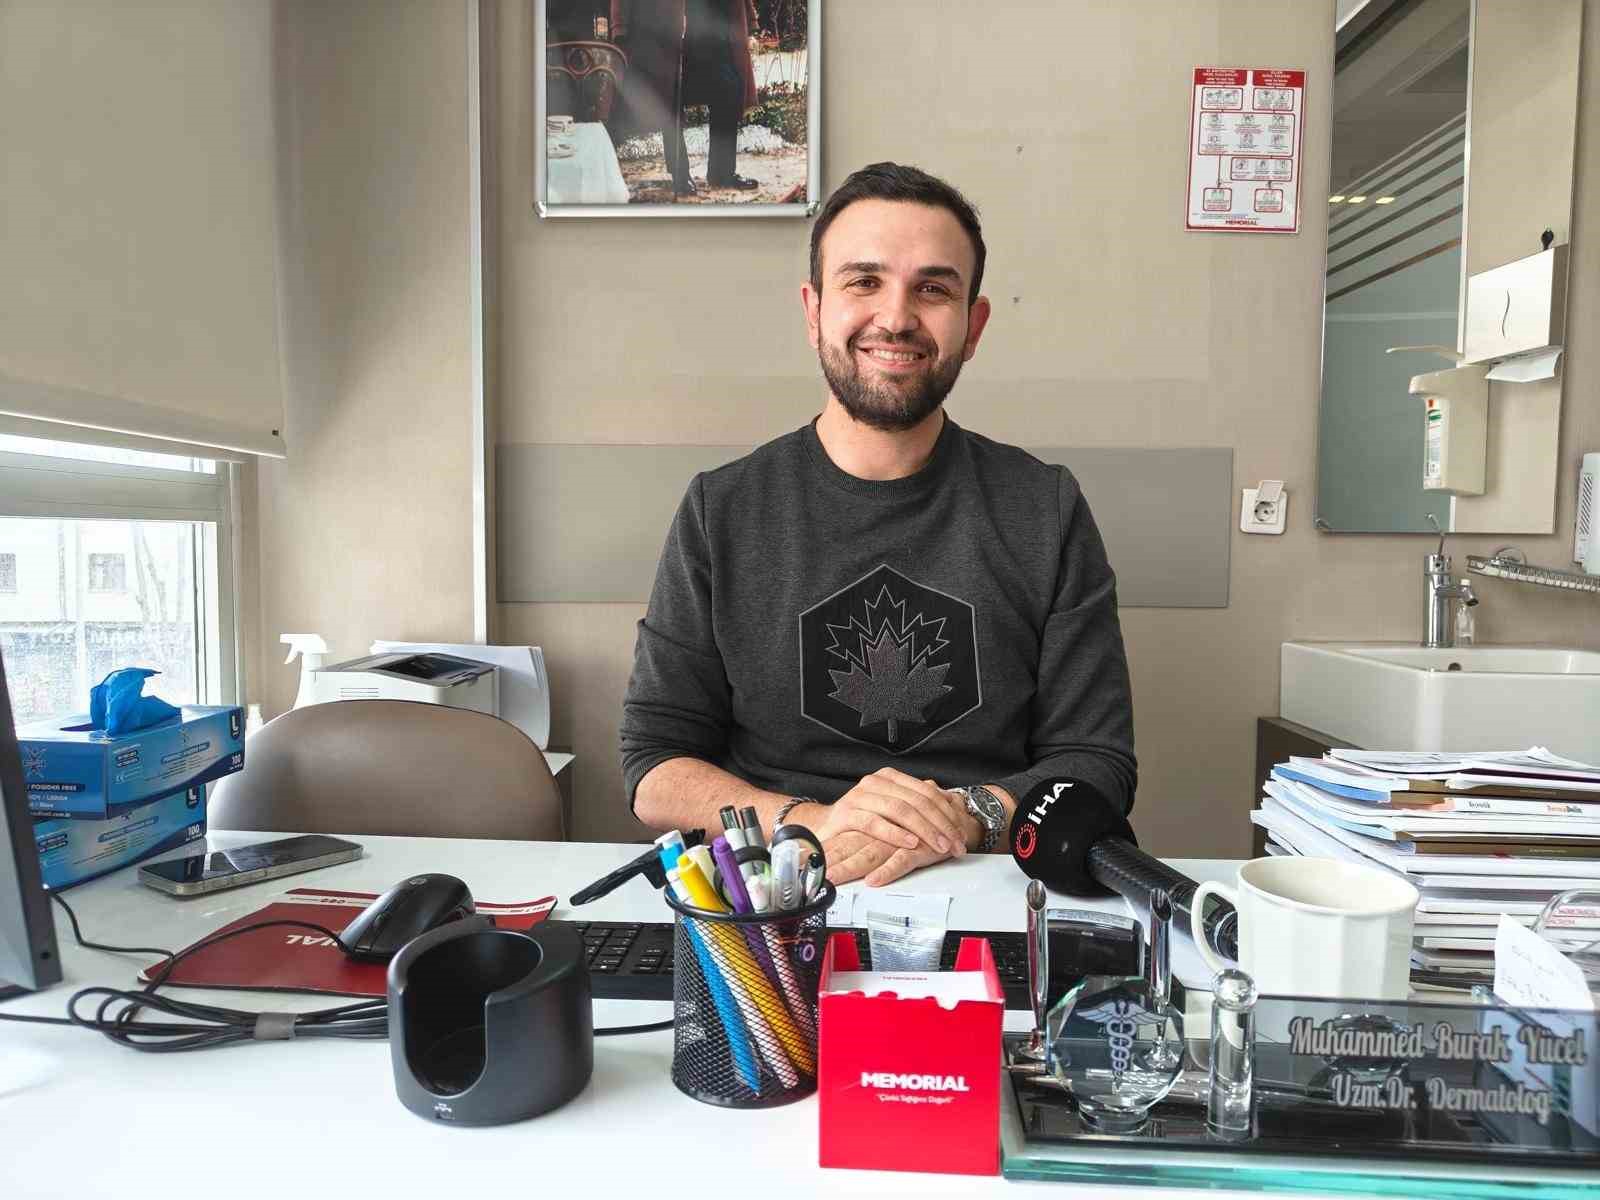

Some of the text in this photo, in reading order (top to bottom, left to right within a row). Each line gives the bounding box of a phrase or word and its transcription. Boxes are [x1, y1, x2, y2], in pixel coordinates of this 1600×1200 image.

[231, 715, 239, 731] L
[1289, 1016, 1587, 1065] Muhammed Burak Yücel
[861, 1072, 970, 1091] MEMORIAL
[1425, 1076, 1552, 1125] Dermatolog
